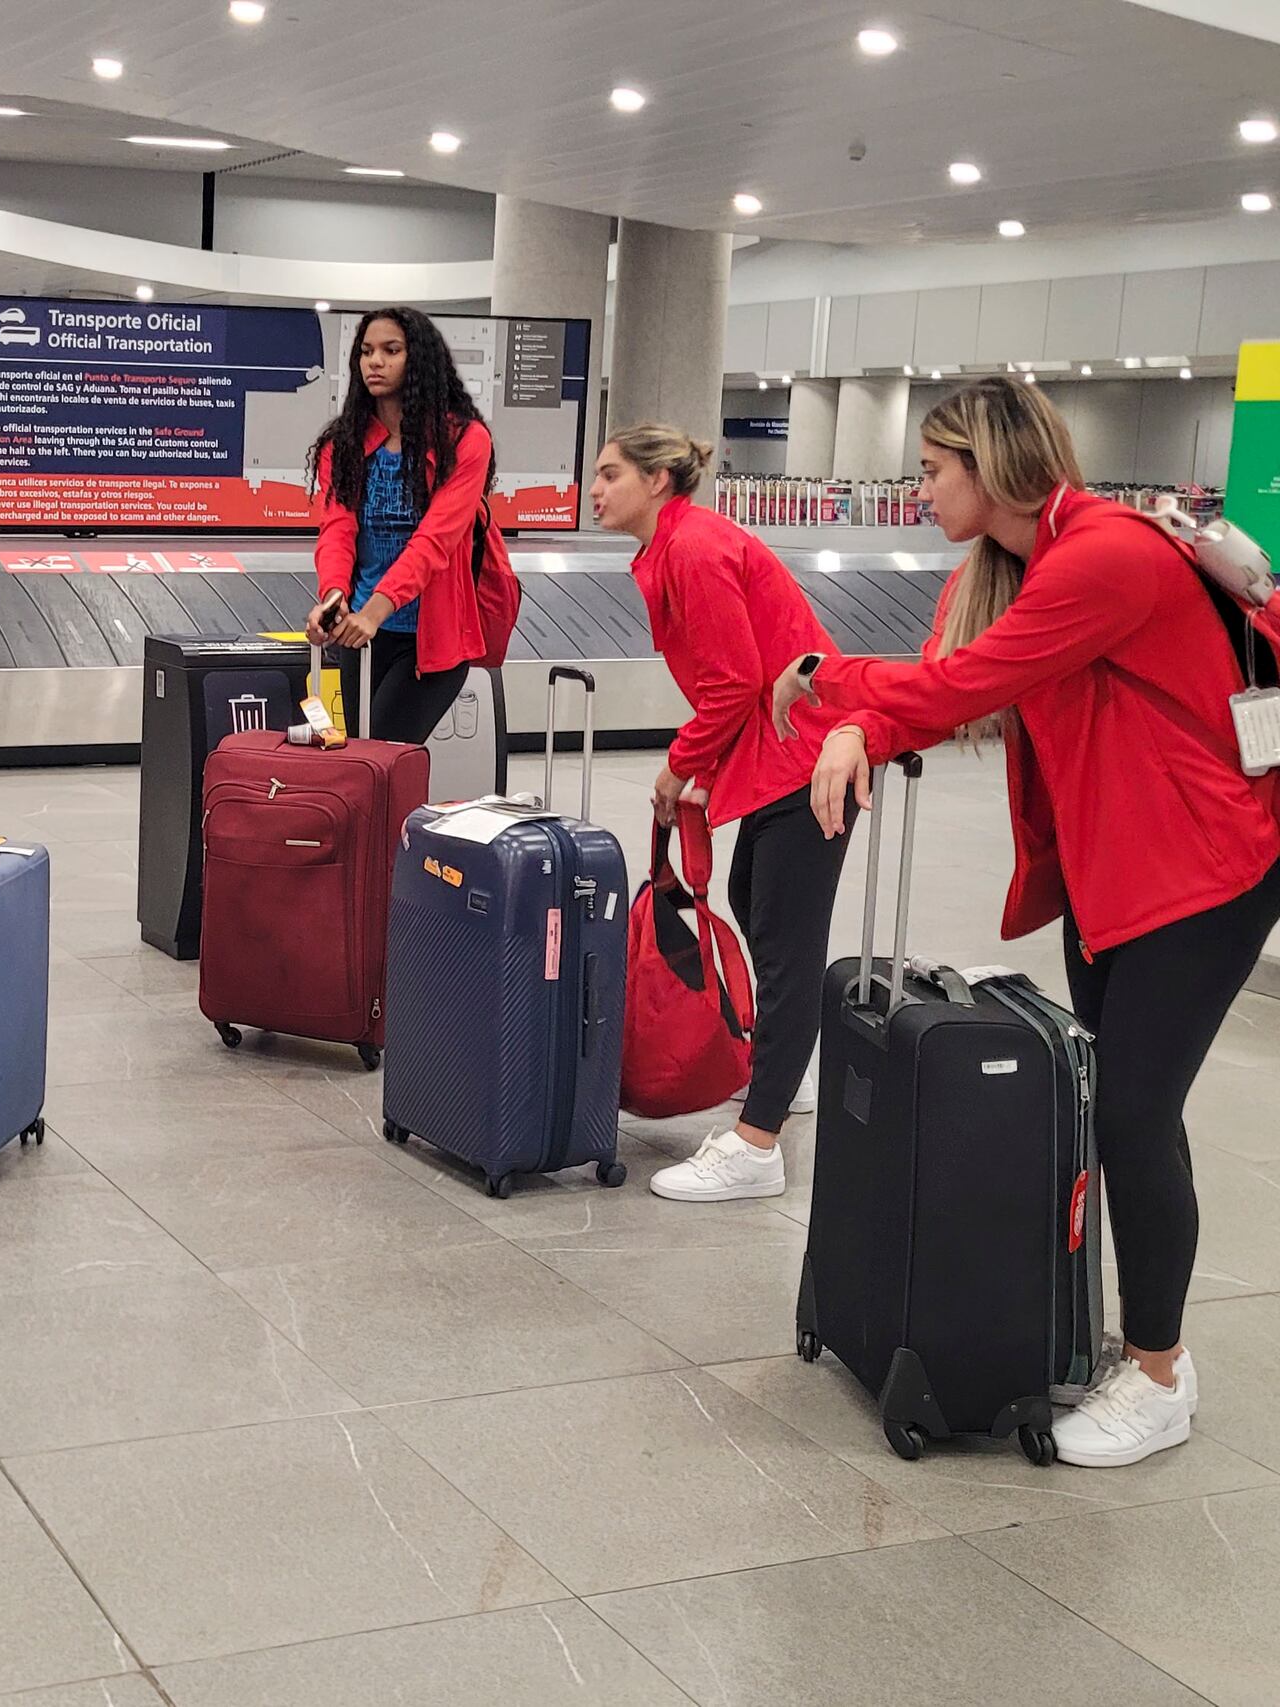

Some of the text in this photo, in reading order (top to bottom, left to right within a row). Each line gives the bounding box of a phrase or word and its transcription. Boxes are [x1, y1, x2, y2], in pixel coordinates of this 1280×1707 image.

[48, 309, 200, 331] Transporte Oficial
[48, 333, 211, 354] Official Transportation
[34, 370, 60, 379] oficial
[74, 371, 82, 380] el
[198, 375, 231, 384] saliendo
[11, 381, 41, 390] control
[43, 382, 53, 391] de
[56, 382, 73, 391] SAG
[75, 385, 81, 393] y
[83, 383, 117, 392] Aduana.
[119, 384, 141, 393] Toma
[142, 384, 150, 393] el
[152, 385, 178, 395] pasillo
[180, 385, 201, 394] hacia
[203, 386, 210, 395] la
[61, 394, 89, 403] locales
[90, 394, 101, 403] de
[103, 395, 126, 404] venta
[128, 395, 138, 404] de
[140, 396, 175, 405] servicios
[176, 397, 187, 405] de
[189, 397, 213, 408] buses,
[216, 398, 234, 407] taxis
[2, 423, 31, 432] official
[33, 424, 92, 435] transportation
[95, 425, 126, 434] services
[129, 426, 136, 434] in
[138, 426, 152, 434] the
[34, 435, 64, 445] leaving
[66, 435, 99, 446] through
[102, 436, 115, 445] the
[117, 436, 135, 445] SAG
[137, 437, 152, 446] and
[154, 437, 188, 446] Customs
[190, 438, 217, 447] control
[9, 446, 24, 454] hall
[26, 446, 35, 455] to
[37, 446, 52, 455] the
[54, 446, 70, 455] left.
[72, 447, 95, 456] There
[97, 449, 113, 457] you
[131, 448, 147, 458] buy
[148, 448, 192, 457] authorized
[194, 449, 210, 459] bus,
[212, 449, 227, 458] taxi
[18, 477, 47, 486] utilices
[49, 478, 84, 486] servicios
[86, 478, 96, 486] de
[98, 478, 140, 489] transporte
[142, 479, 166, 489] ilegal.
[169, 480, 177, 488] Te
[179, 482, 212, 490] expones
[19, 489, 60, 498] excesivos,
[62, 489, 91, 497] estafas
[93, 491, 98, 499] y
[100, 490, 121, 498] otros
[123, 490, 154, 500] riesgos.
[33, 500, 57, 509] illegal
[60, 500, 118, 510] transportation
[120, 501, 153, 509] services.
[156, 501, 171, 509] You
[173, 501, 195, 509] could
[197, 502, 206, 510] be
[43, 511, 59, 519] and
[61, 511, 71, 519] be
[73, 511, 107, 521] exposed
[109, 512, 118, 520] to
[145, 512, 161, 520] and
[163, 512, 185, 520] other
[186, 512, 219, 522] dangers.
